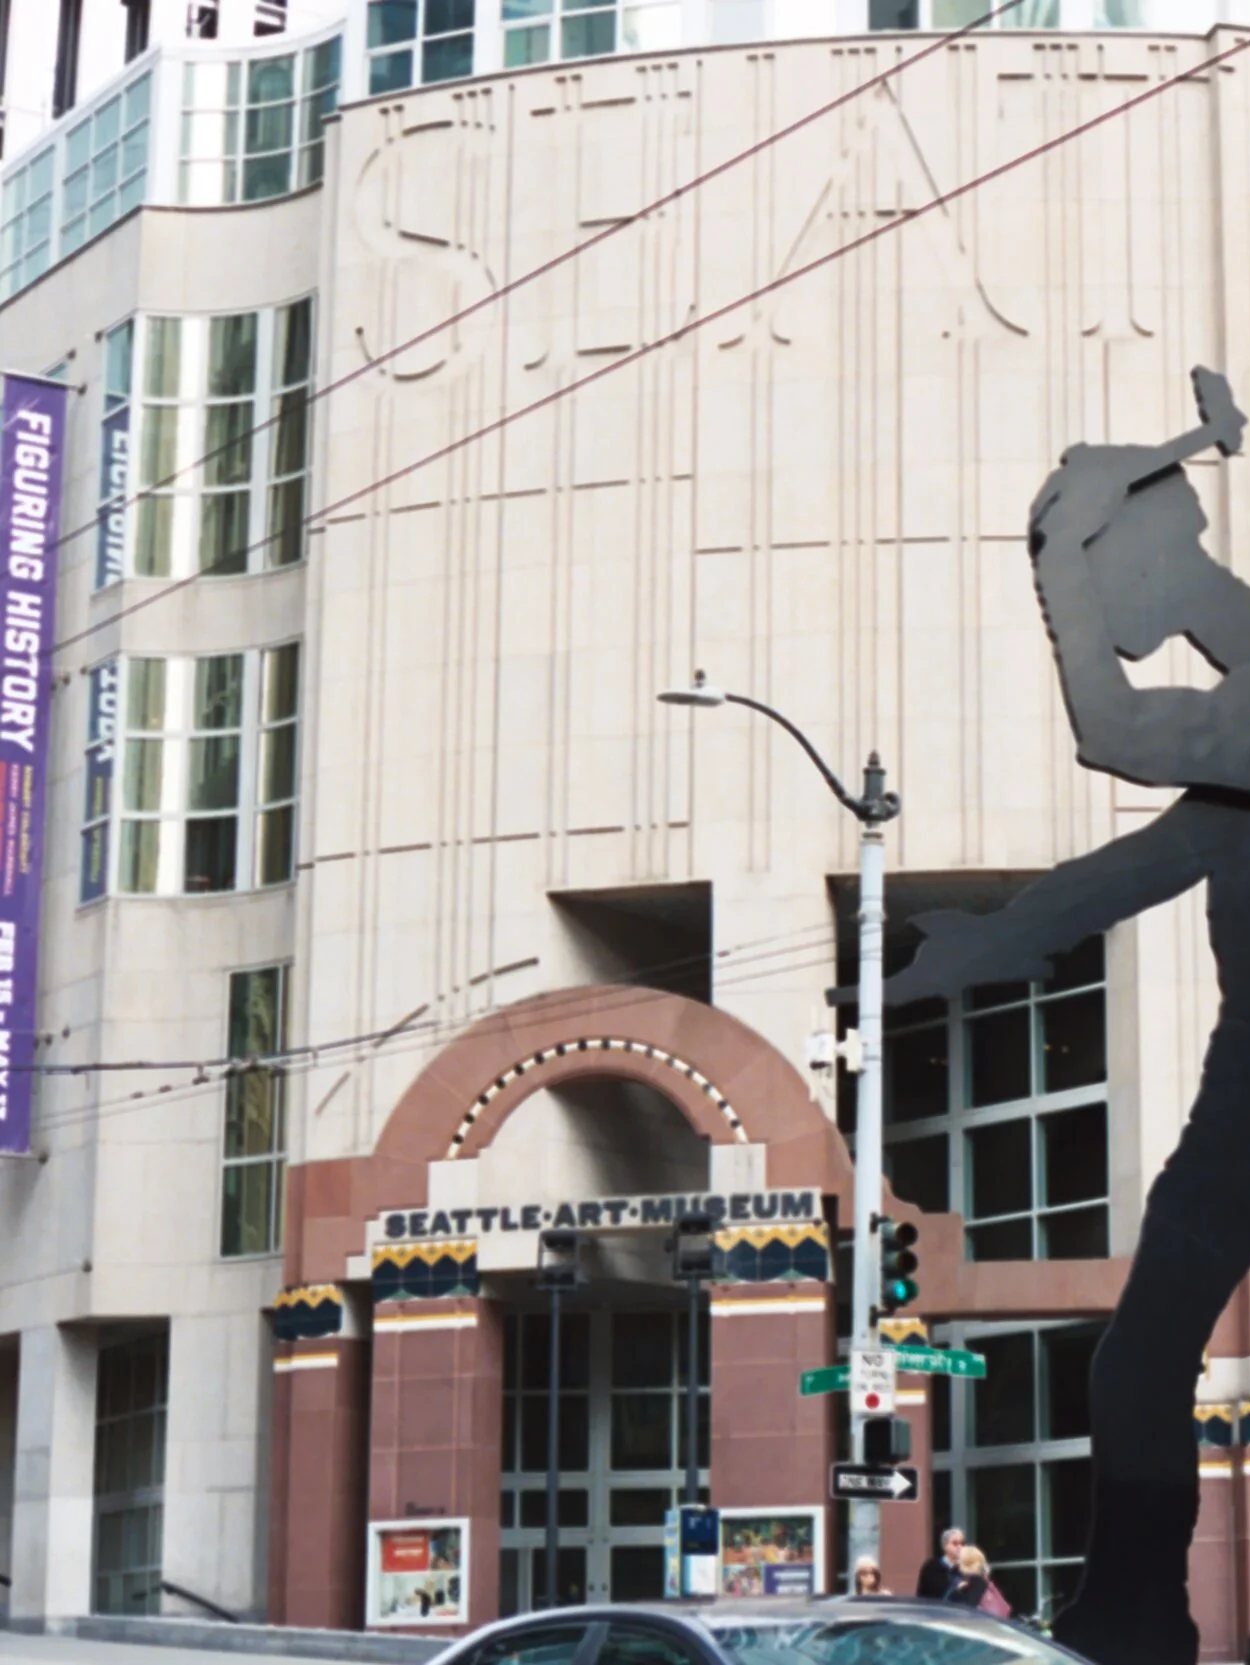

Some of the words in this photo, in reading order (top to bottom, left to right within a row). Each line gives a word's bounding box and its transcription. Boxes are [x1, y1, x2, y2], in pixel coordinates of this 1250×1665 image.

[9, 410, 51, 582] FIGURING
[1, 590, 42, 754] HISTORY
[384, 1202, 542, 1238] SEATTLE
[553, 1199, 628, 1229] ART
[640, 1191, 815, 1226] MUSEUM
